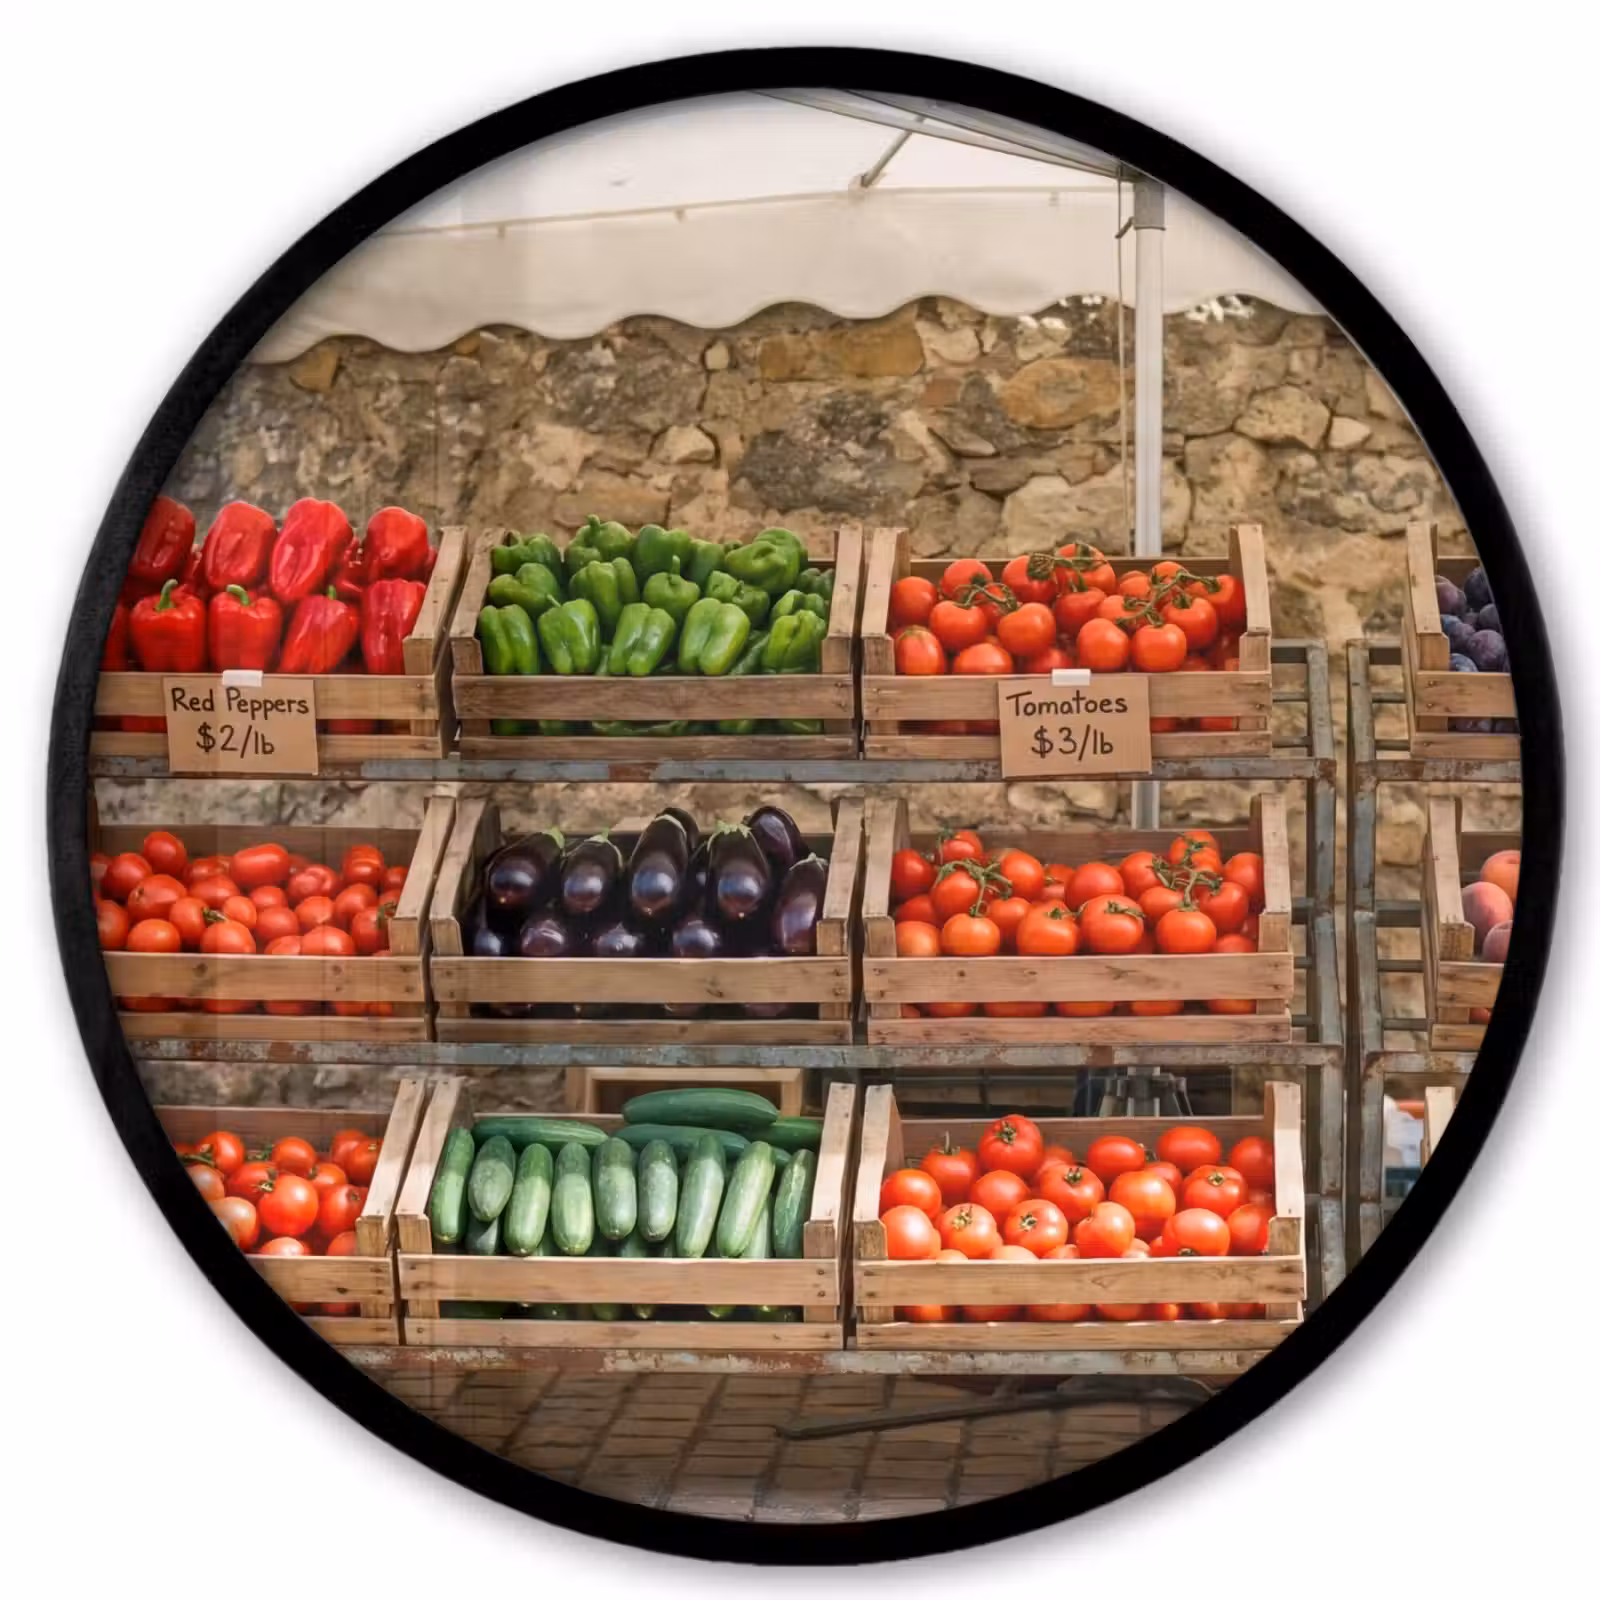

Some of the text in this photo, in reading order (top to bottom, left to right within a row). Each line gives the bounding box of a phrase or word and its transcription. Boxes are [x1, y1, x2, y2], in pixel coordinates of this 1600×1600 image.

[171, 686, 309, 720] Red Peppers
[1006, 689, 1128, 716] Tomatoes
[196, 722, 275, 759] $2/lb
[1031, 724, 1114, 762] $3/lb
